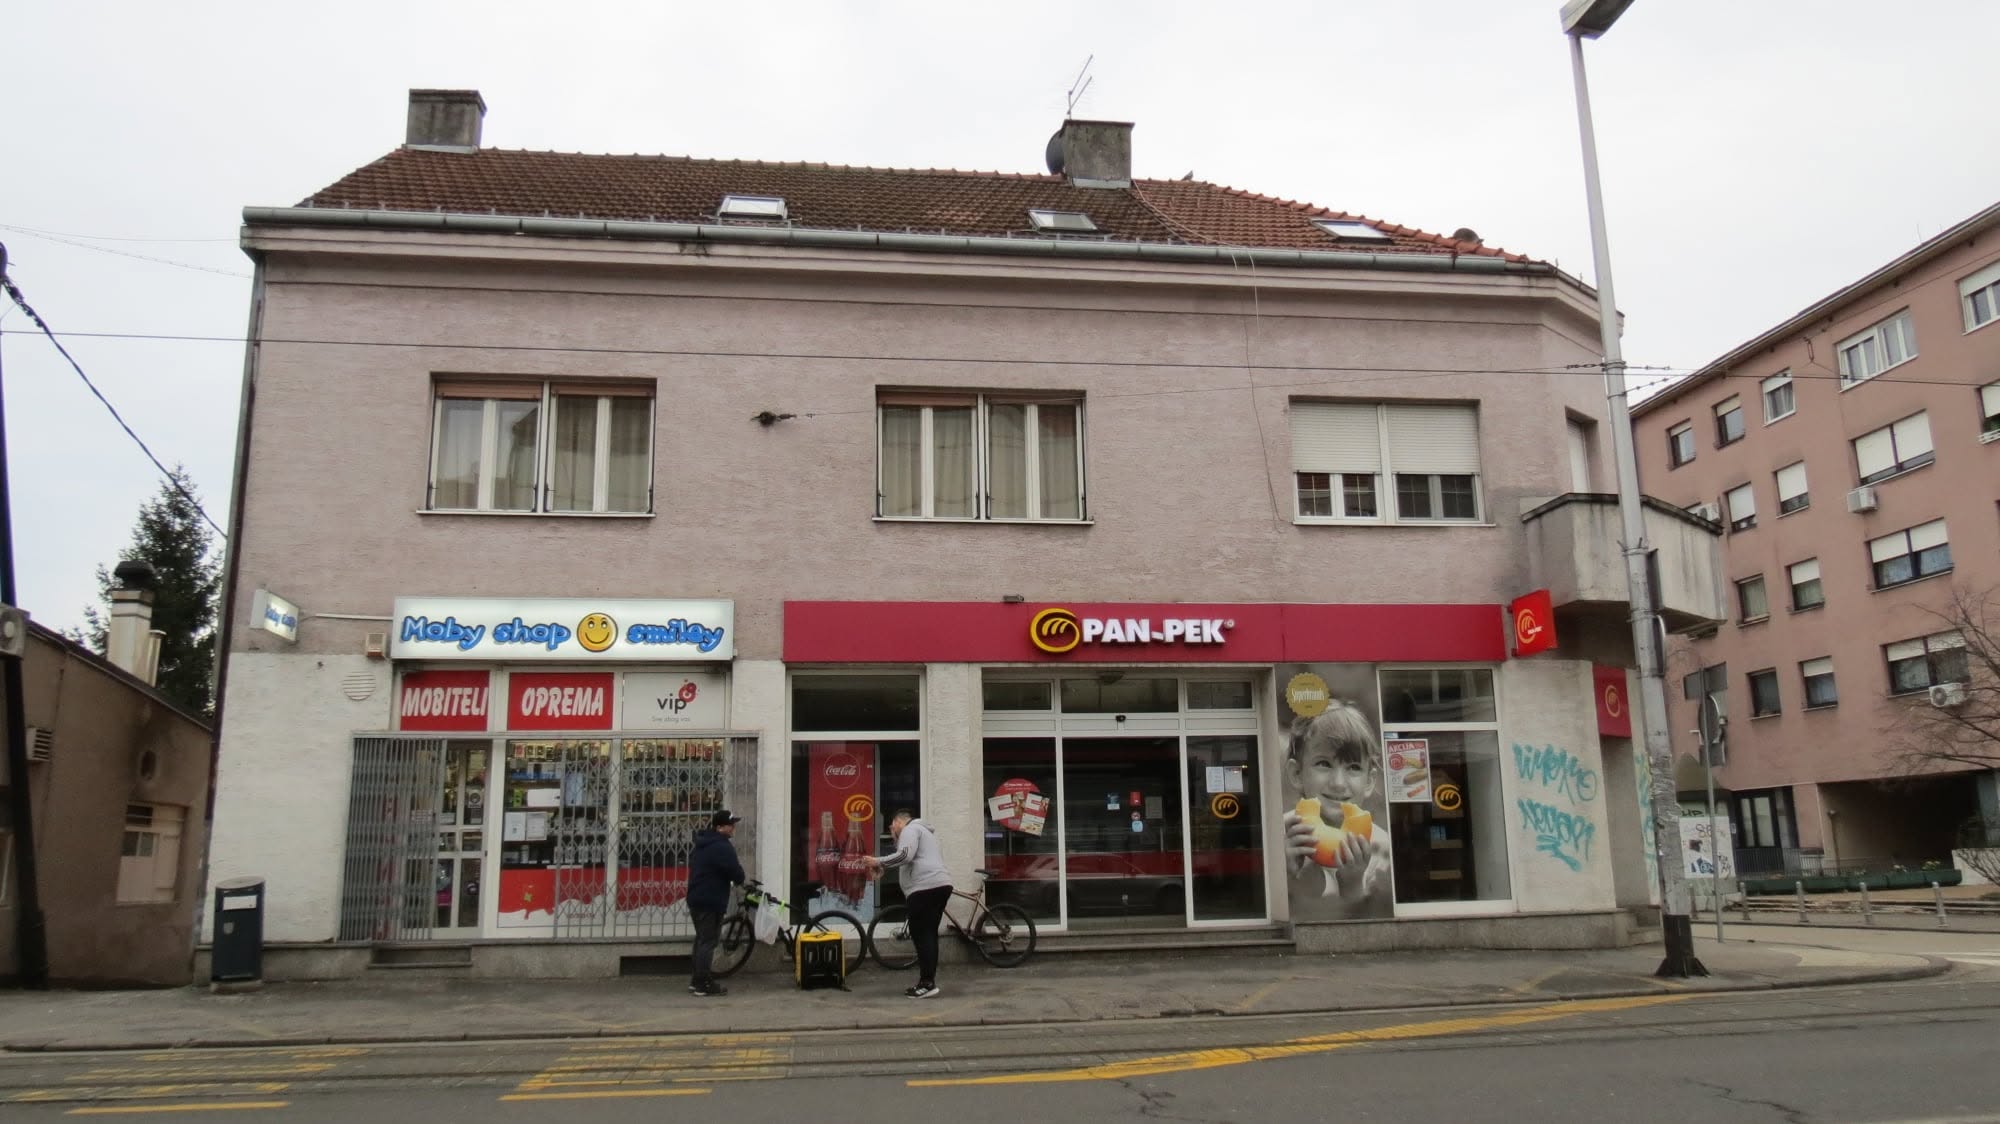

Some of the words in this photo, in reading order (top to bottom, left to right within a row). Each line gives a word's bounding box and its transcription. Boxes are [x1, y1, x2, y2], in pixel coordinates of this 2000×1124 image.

[402, 616, 486, 650] Moby
[492, 617, 571, 650] shop
[626, 618, 724, 652] smiley
[402, 687, 489, 717] MOBITELI
[521, 687, 604, 718] OPREMA
[656, 693, 687, 714] vip
